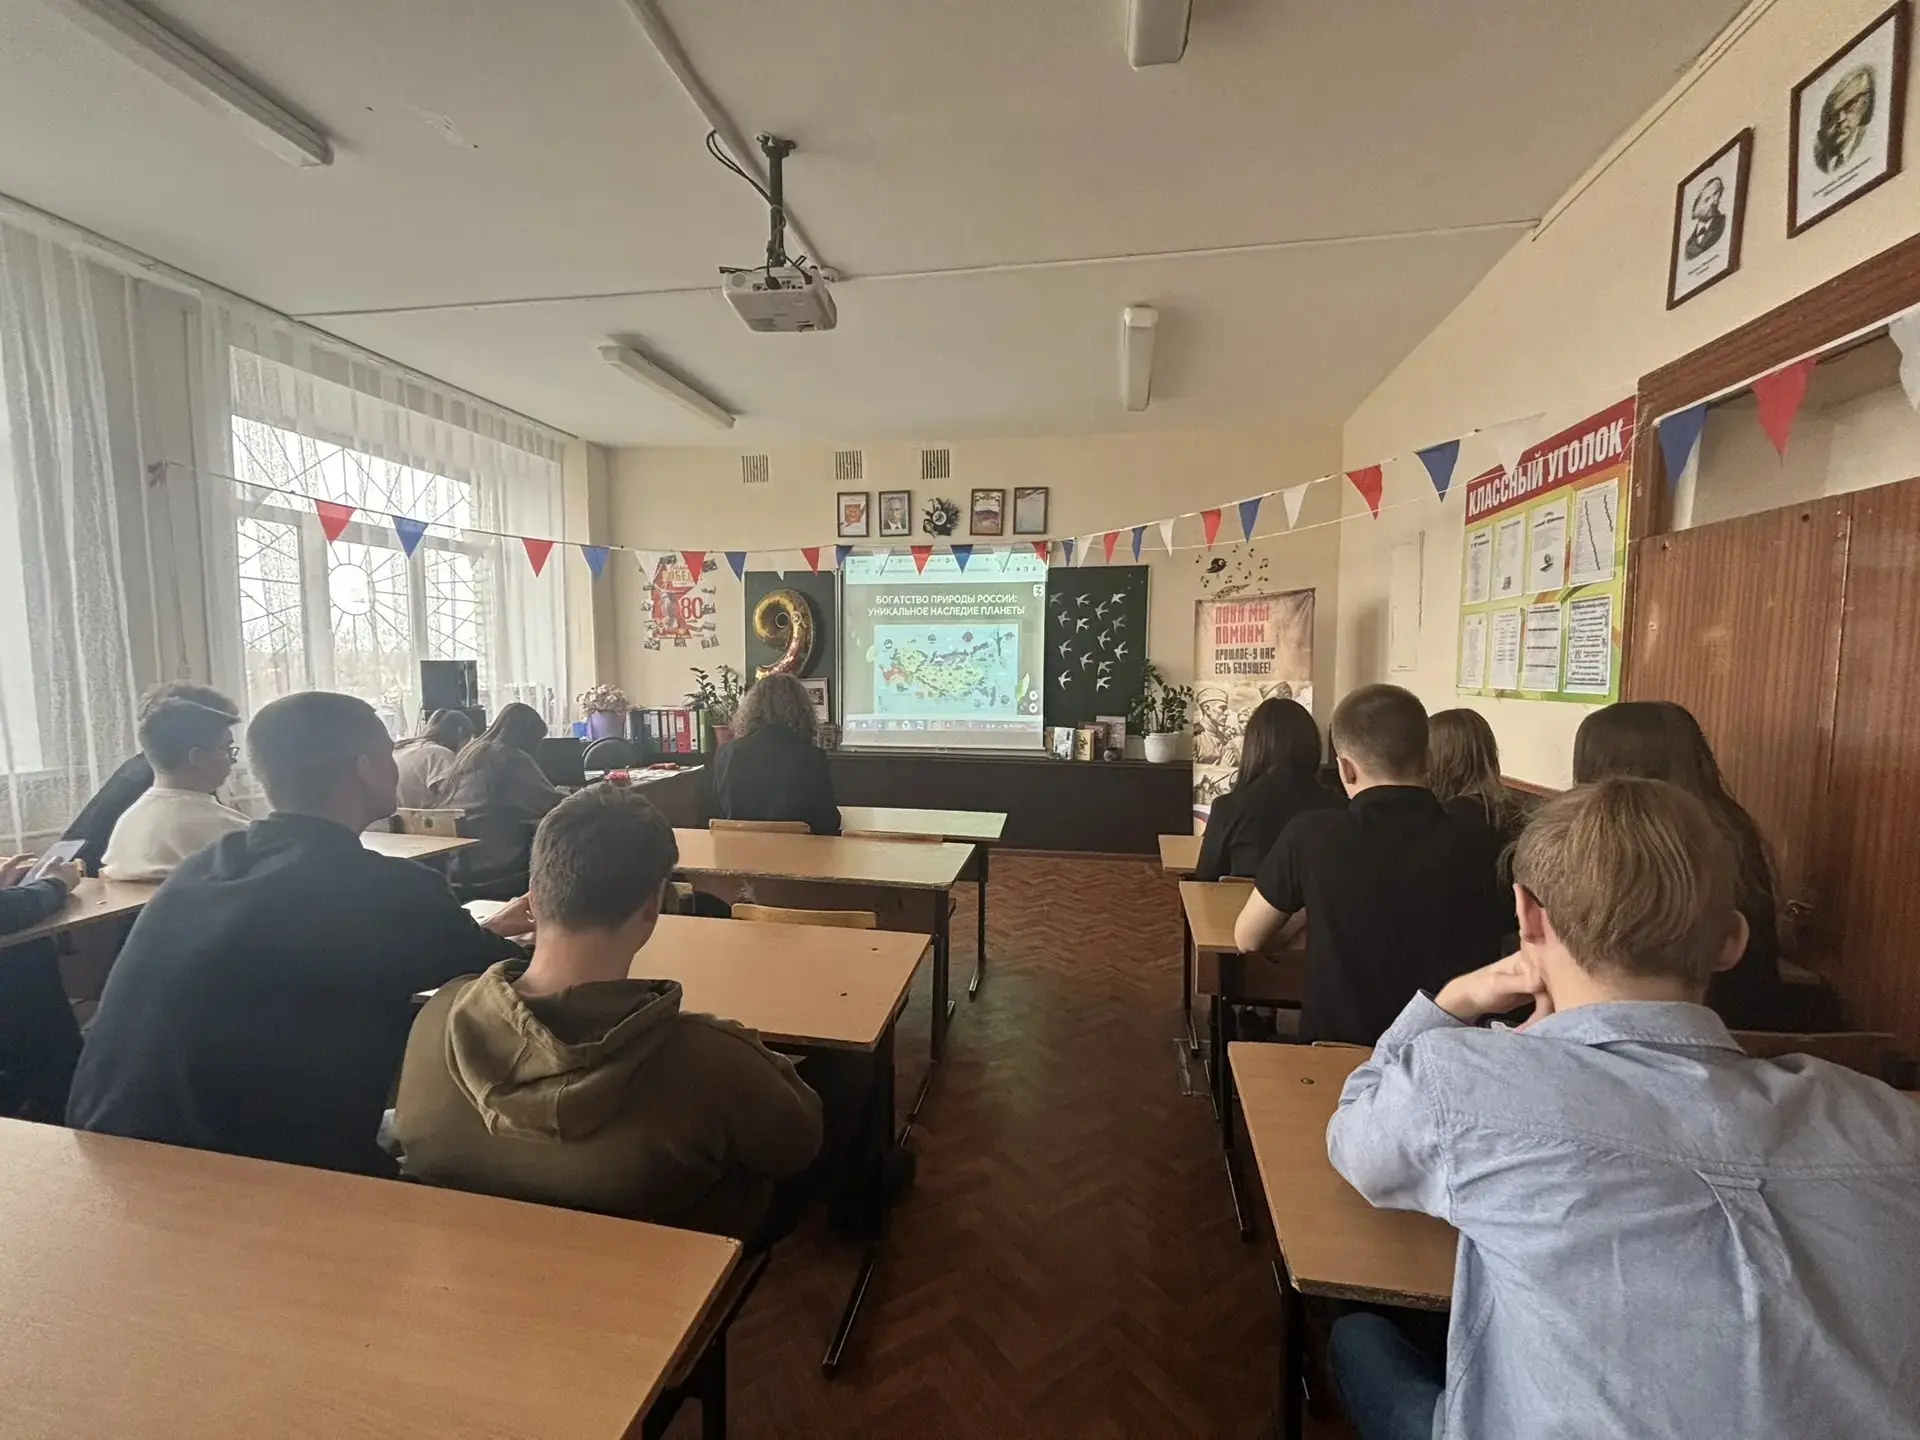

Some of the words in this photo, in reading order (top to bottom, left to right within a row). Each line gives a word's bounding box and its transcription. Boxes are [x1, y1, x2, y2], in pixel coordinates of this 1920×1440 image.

[1468, 452, 1543, 517] КЛАССНЫЙ
[1548, 418, 1624, 483] УГОЛОК
[876, 595, 929, 604] БОГАТСТВО
[931, 594, 975, 604] ПРИРОДЫ
[977, 594, 1018, 603] РОССИИ:
[680, 597, 704, 619] 80
[868, 607, 929, 616] УНИКАЛЬНОЕ
[930, 606, 979, 616] НАСЛЕДИЕ
[981, 606, 1025, 615] ПЛАНЕТЫ
[1249, 603, 1270, 622] МЫ
[1216, 624, 1265, 644] ПОМНИМ
[1260, 647, 1276, 659] НАС
[1215, 662, 1231, 674] ЕСТЬ
[1233, 662, 1271, 675] БУДУЩЕЕ!
